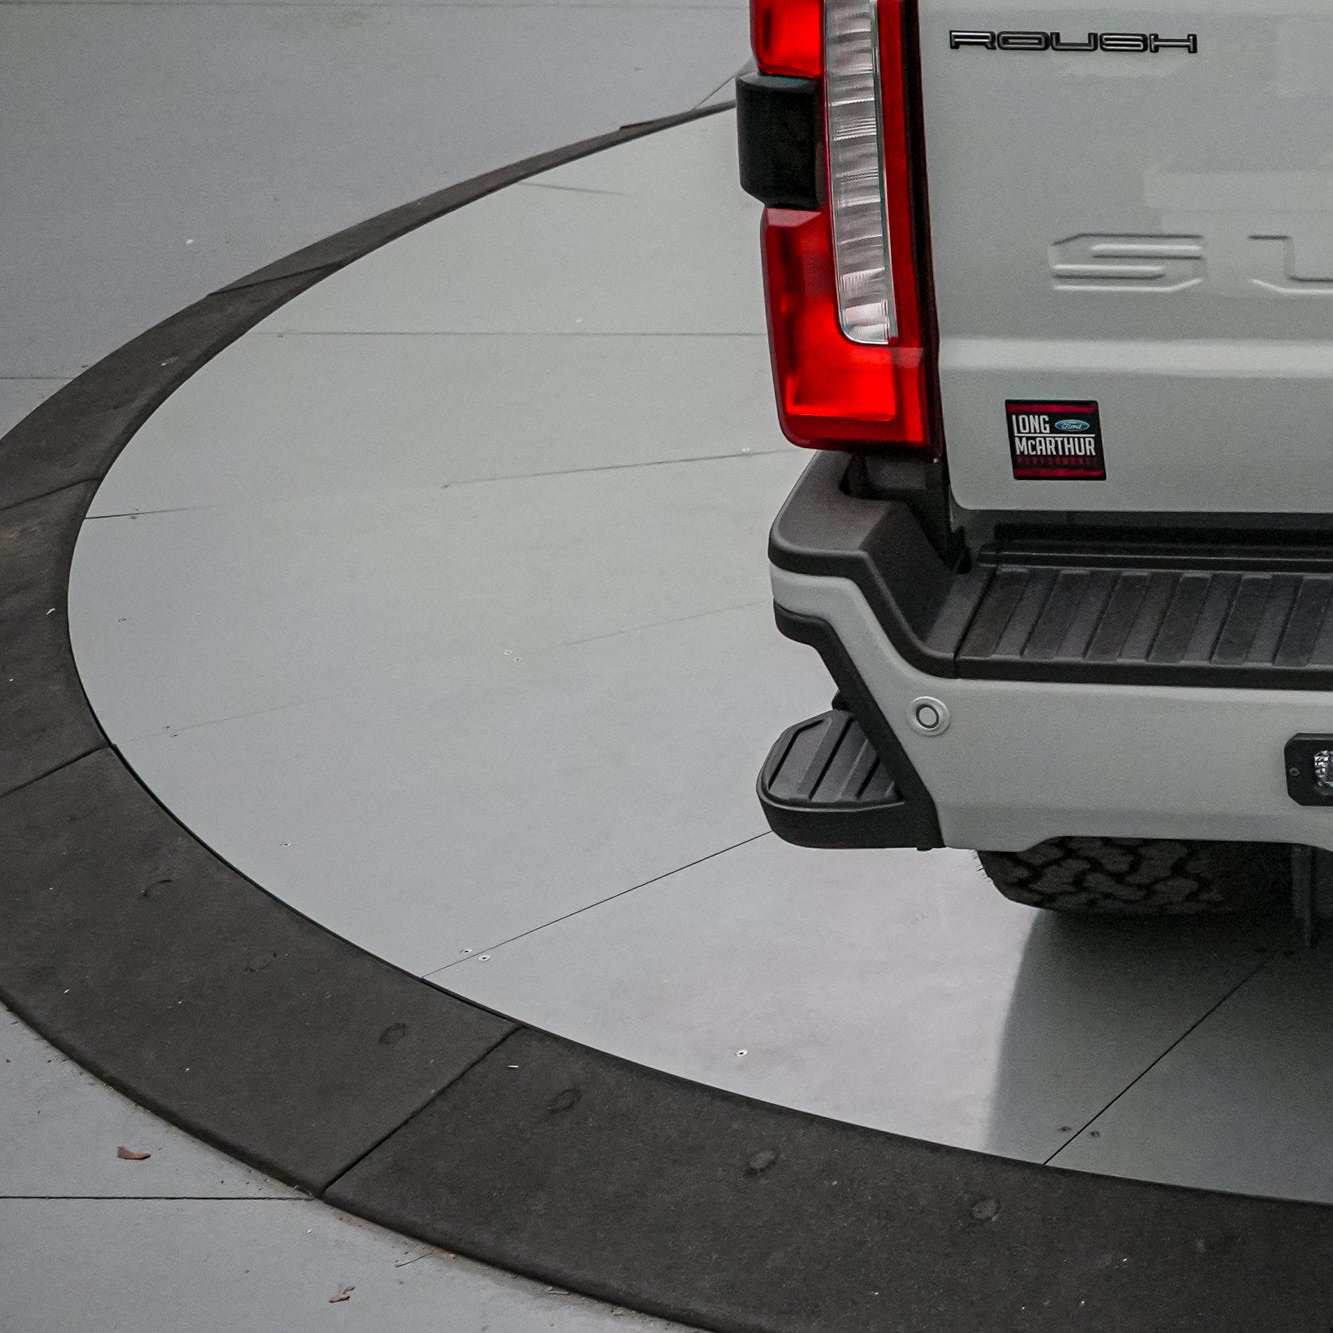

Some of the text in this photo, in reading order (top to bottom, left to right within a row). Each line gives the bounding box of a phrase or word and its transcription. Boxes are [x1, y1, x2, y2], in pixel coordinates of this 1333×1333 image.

[949, 29, 1198, 54] ROUSH
[1012, 414, 1051, 435] LONG
[1014, 436, 1096, 456] McARTHUR
